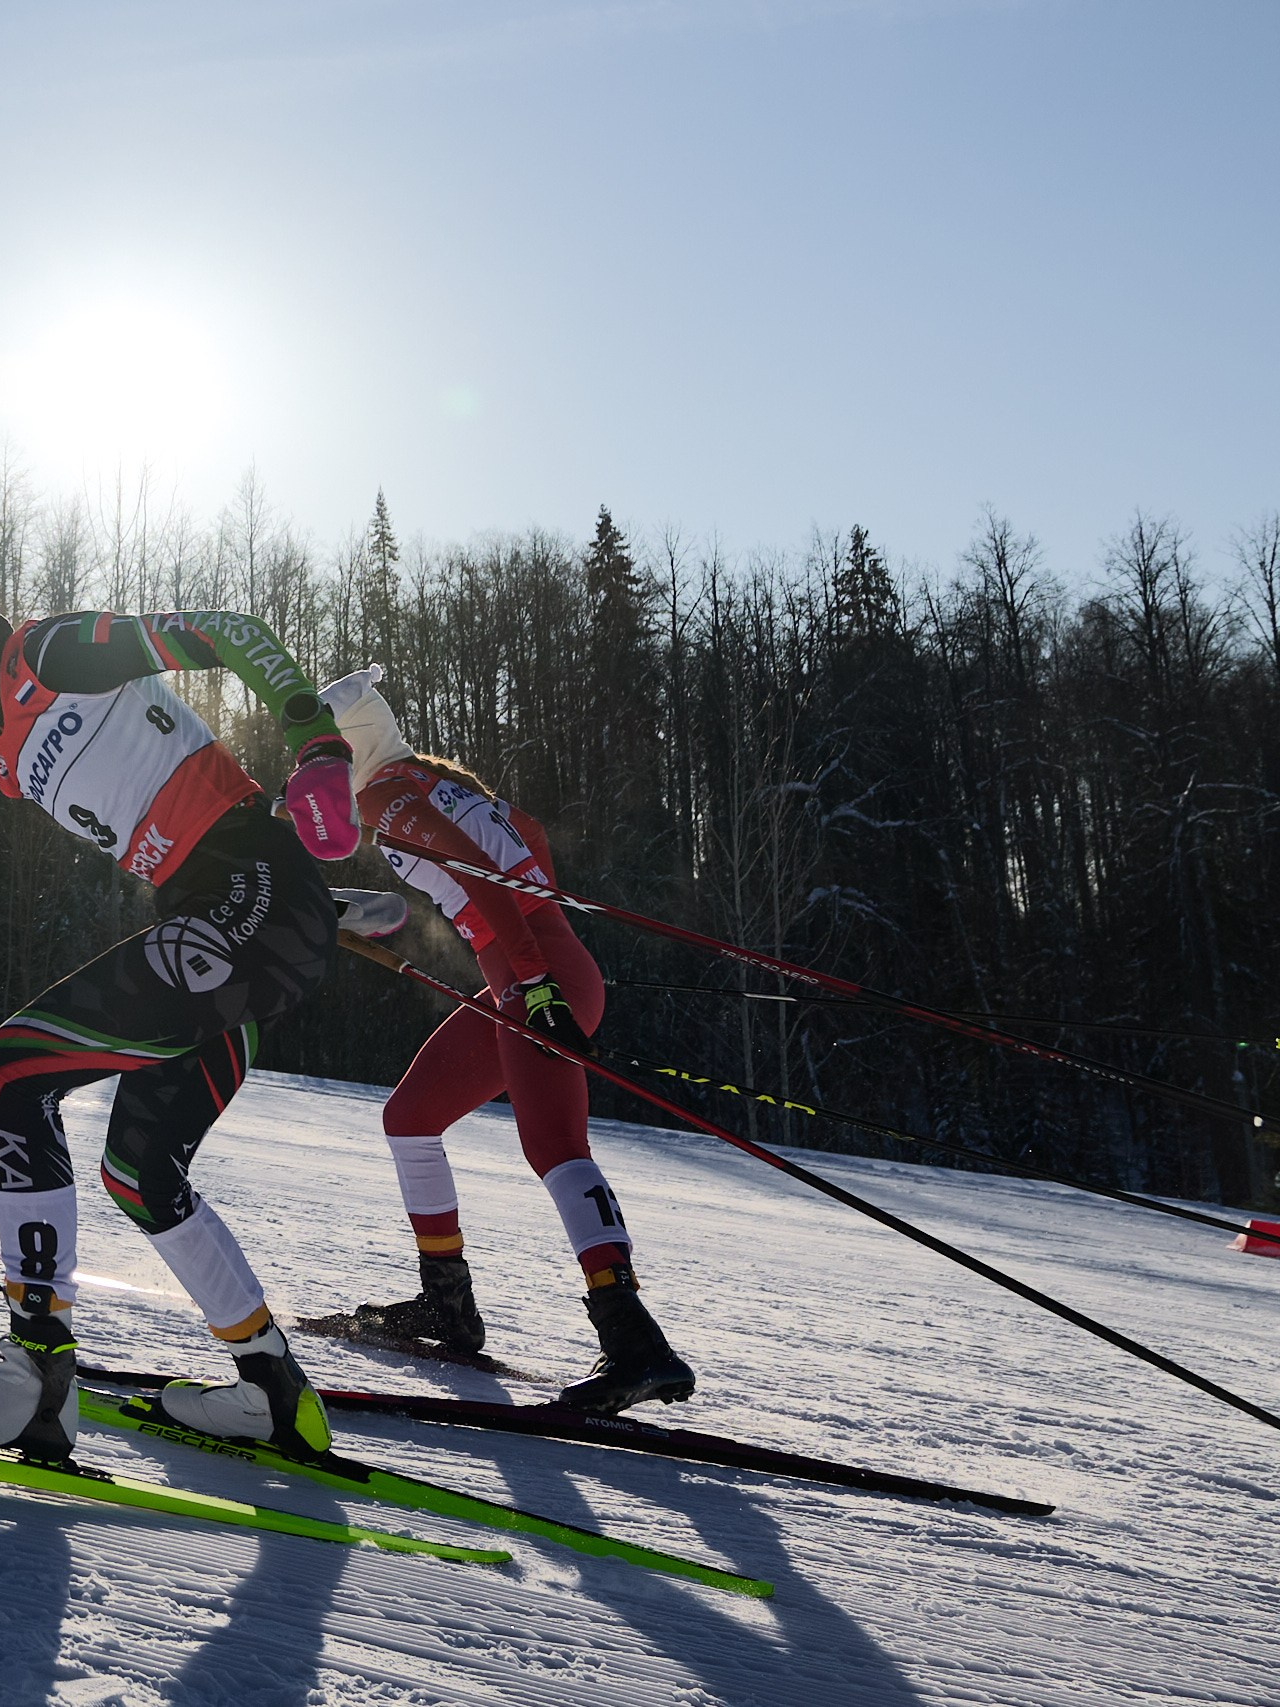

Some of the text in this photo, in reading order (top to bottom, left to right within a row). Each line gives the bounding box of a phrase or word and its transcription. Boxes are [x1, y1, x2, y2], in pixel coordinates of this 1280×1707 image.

[152, 611, 299, 693] TATARSTAN
[146, 704, 176, 735] 8
[68, 803, 118, 848] 8
[227, 861, 272, 945] Компания
[18, 1221, 59, 1281] 8
[138, 1422, 257, 1463] FISCHER
[584, 1416, 635, 1432] ATOMIC
